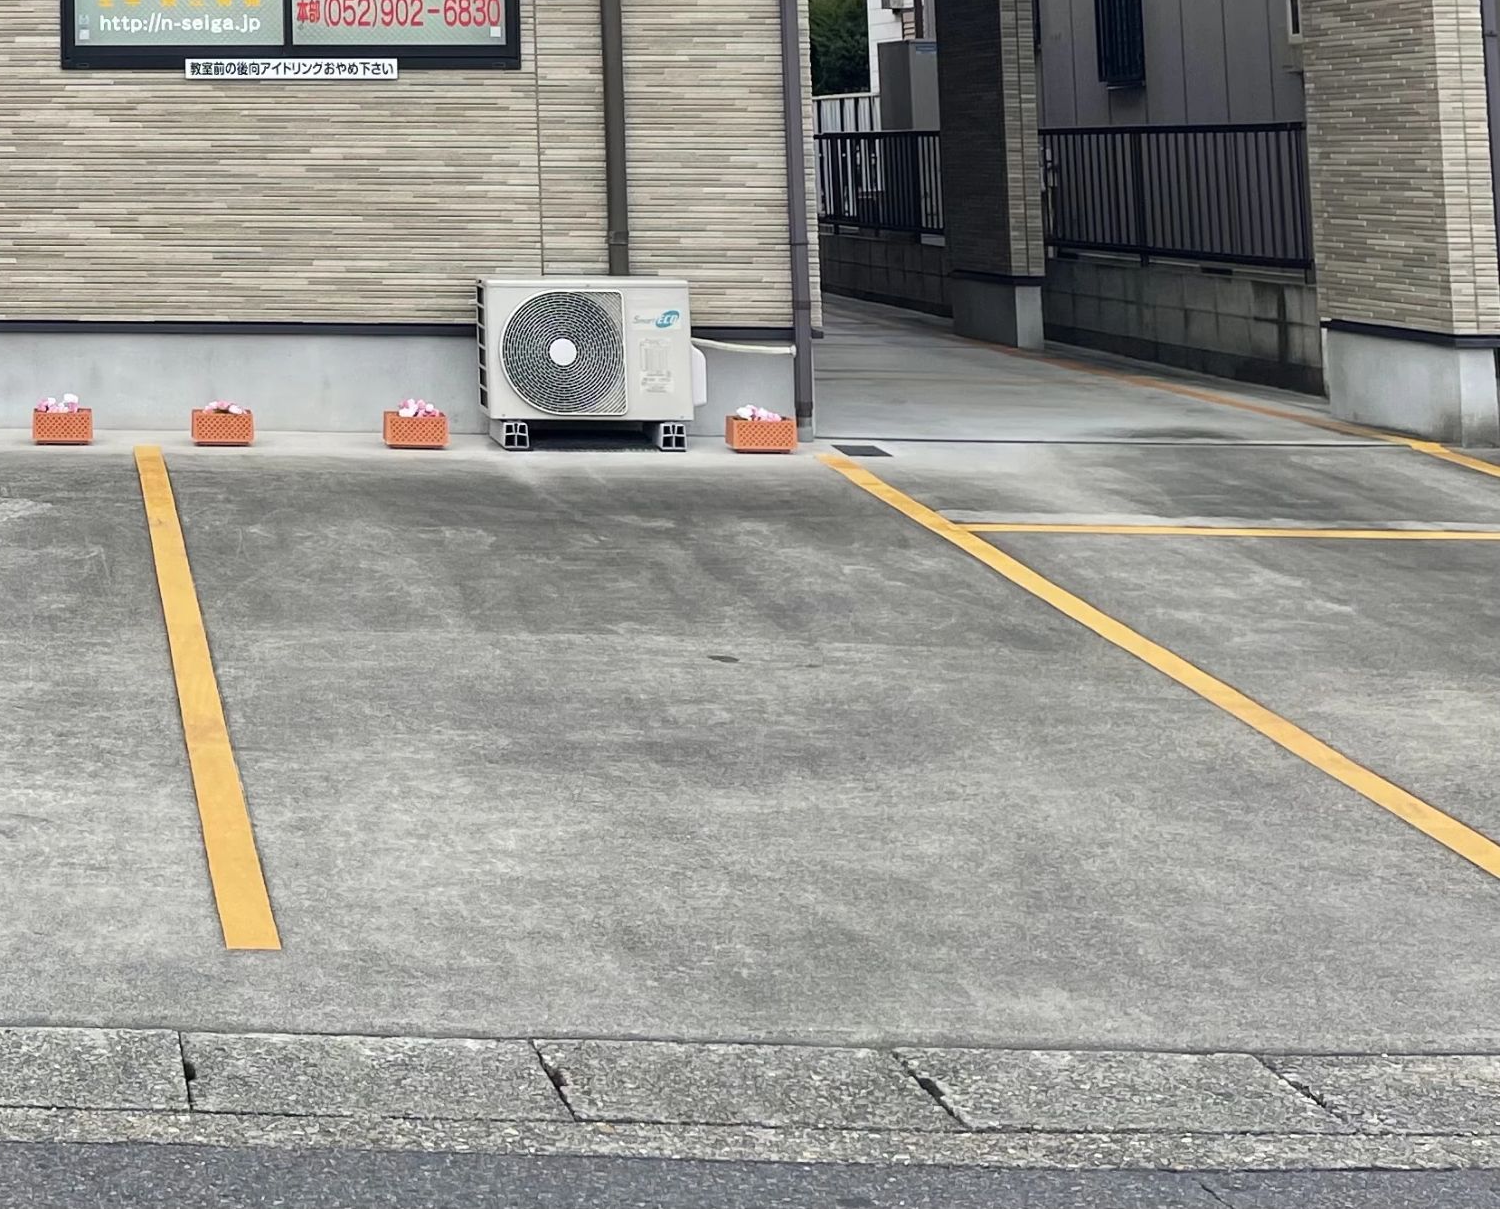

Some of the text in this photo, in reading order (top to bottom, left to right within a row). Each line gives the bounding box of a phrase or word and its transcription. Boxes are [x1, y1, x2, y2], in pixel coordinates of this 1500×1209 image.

[297, 0, 320, 23] 本部
[100, 13, 261, 33] http://n-seiga.jp
[190, 61, 394, 76] 教室前の後向アイドリングおやめ下さい
